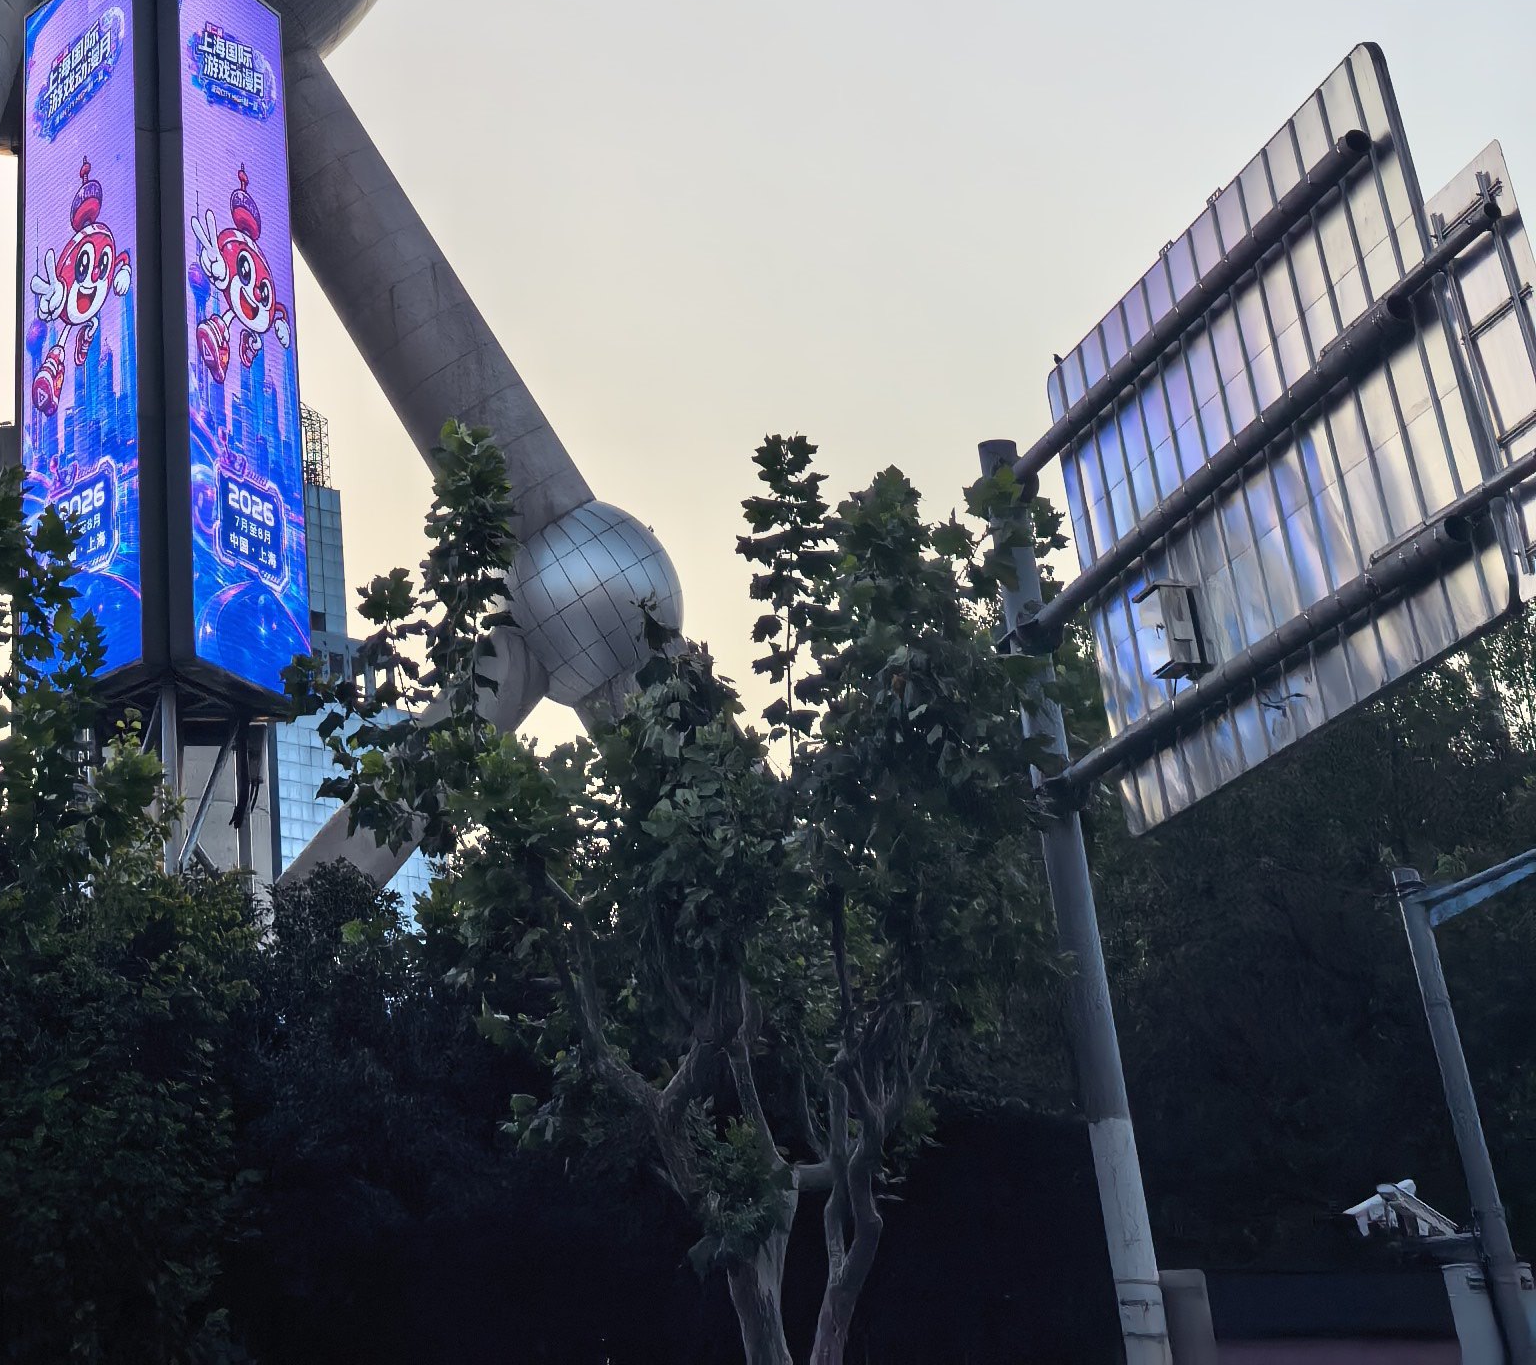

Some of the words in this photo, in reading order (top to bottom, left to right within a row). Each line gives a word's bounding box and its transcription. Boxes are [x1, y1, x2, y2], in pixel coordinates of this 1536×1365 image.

[44, 21, 100, 100] 上海国际
[198, 32, 252, 68] 上海国际
[204, 53, 264, 96] 游戏动漫月
[228, 482, 275, 526] 2026
[235, 515, 271, 545] 7月至8月
